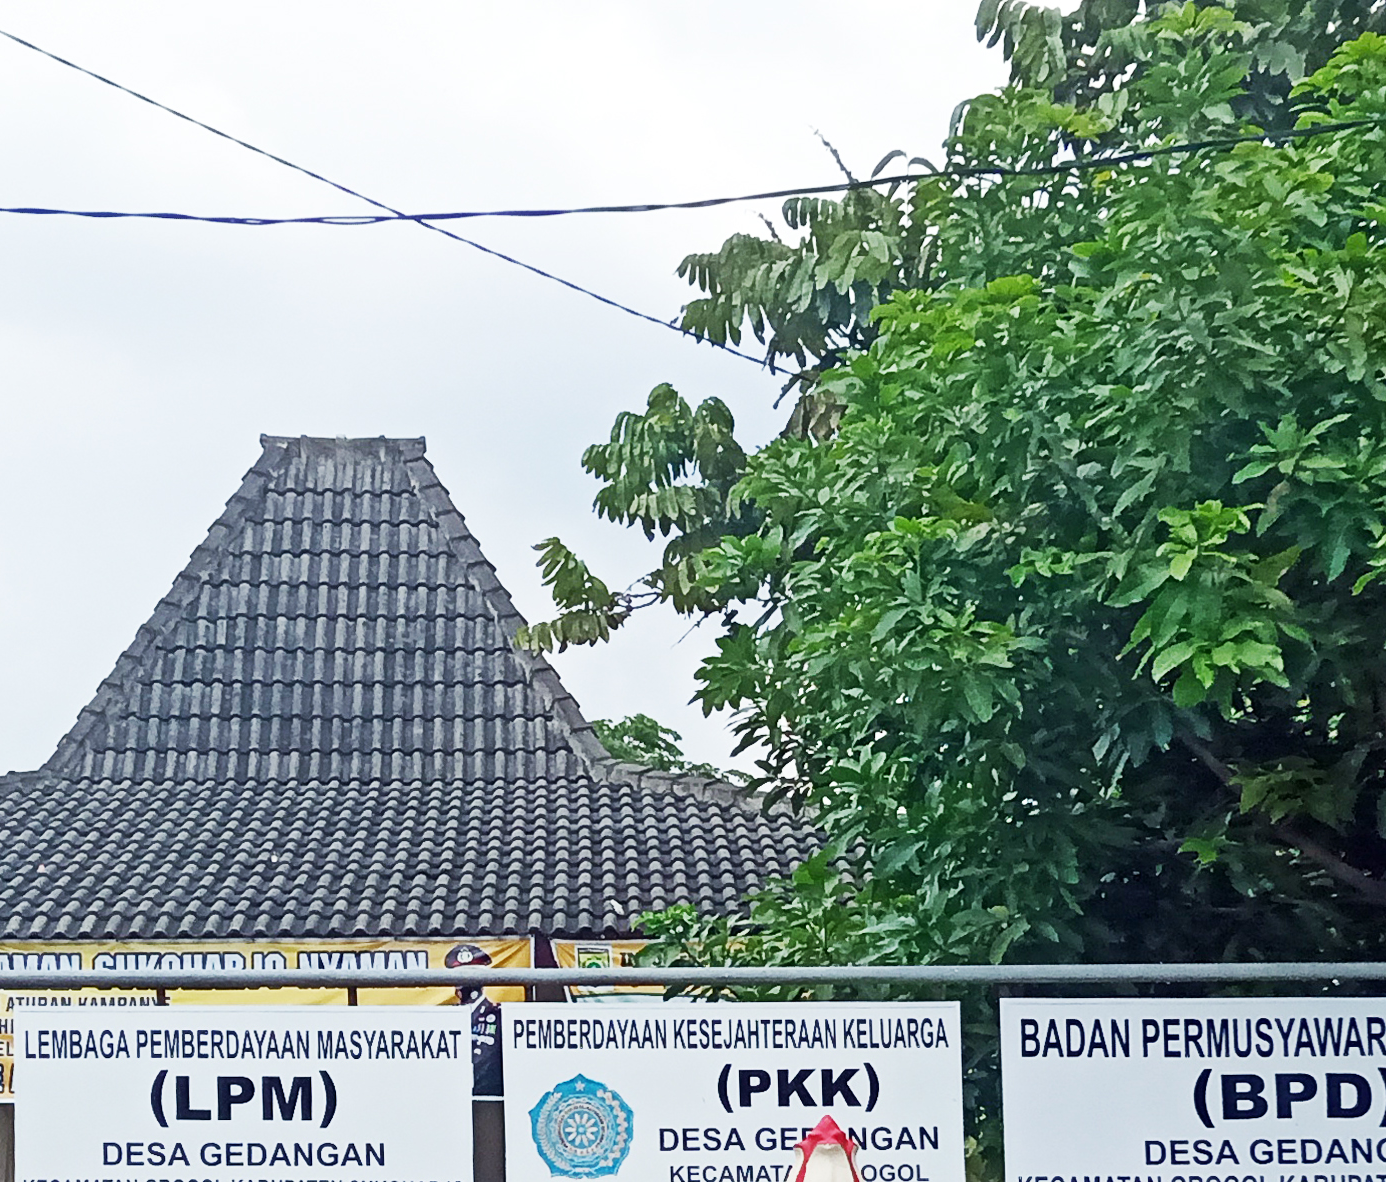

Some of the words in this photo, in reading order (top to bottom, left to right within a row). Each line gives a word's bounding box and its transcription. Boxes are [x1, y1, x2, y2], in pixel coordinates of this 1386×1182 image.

[25, 1029, 131, 1059] LEMBAGA
[136, 1029, 310, 1060] PEMBERDAYAAN
[317, 1029, 462, 1060] MASYARAKAT
[513, 1019, 667, 1050] PEMBERDAYAAN
[673, 1018, 837, 1050] KESEJAHTERAAN
[843, 1017, 949, 1049] KELUARGA
[1020, 1018, 1130, 1058] BADAN
[150, 1069, 337, 1129] (LPM)
[717, 1062, 880, 1114] (PKK)
[102, 1142, 191, 1167] DESA
[199, 1142, 385, 1167] GEDANGAN
[659, 1127, 746, 1152] DESA
[754, 1126, 940, 1153] GENGAN
[1144, 1139, 1240, 1166] DESA
[860, 1163, 930, 1182] OGOL
